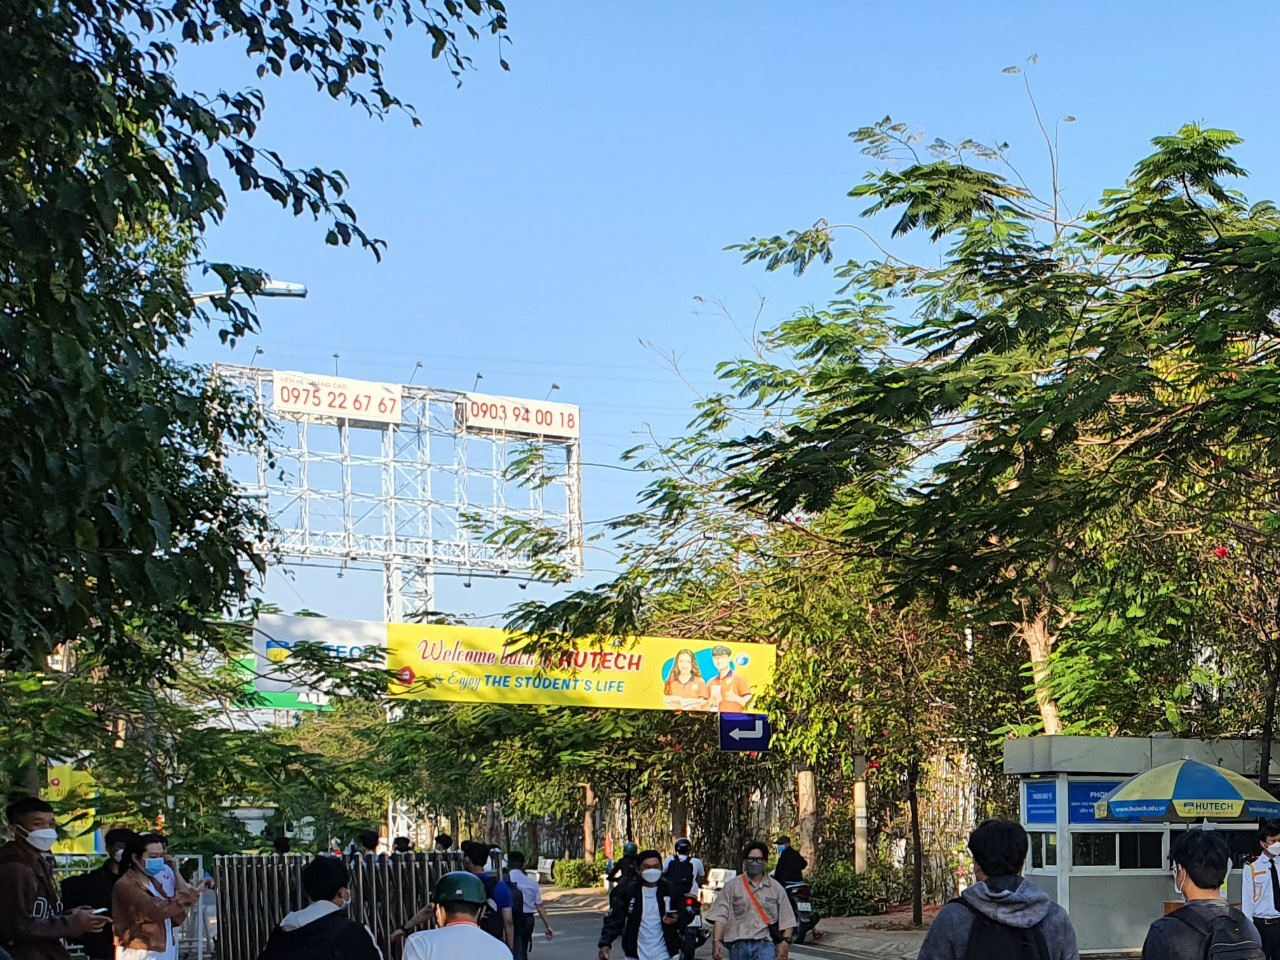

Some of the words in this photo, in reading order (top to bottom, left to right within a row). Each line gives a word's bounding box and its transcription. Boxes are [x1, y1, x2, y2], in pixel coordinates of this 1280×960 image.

[280, 386, 321, 407] 0975
[327, 391, 347, 409] 22
[353, 394, 372, 412] 67
[378, 397, 396, 414] 67
[471, 401, 507, 420] 0903
[512, 406, 530, 423] 94
[535, 409, 553, 426] 00
[560, 412, 575, 429] 18
[418, 639, 496, 665] Welcome
[557, 650, 643, 671] HUTECH
[447, 670, 481, 691] Enjoy
[484, 674, 510, 688] THE
[514, 676, 592, 692] STUDENT'S
[596, 680, 625, 693] LIFE
[1195, 802, 1234, 811] HUTECH
